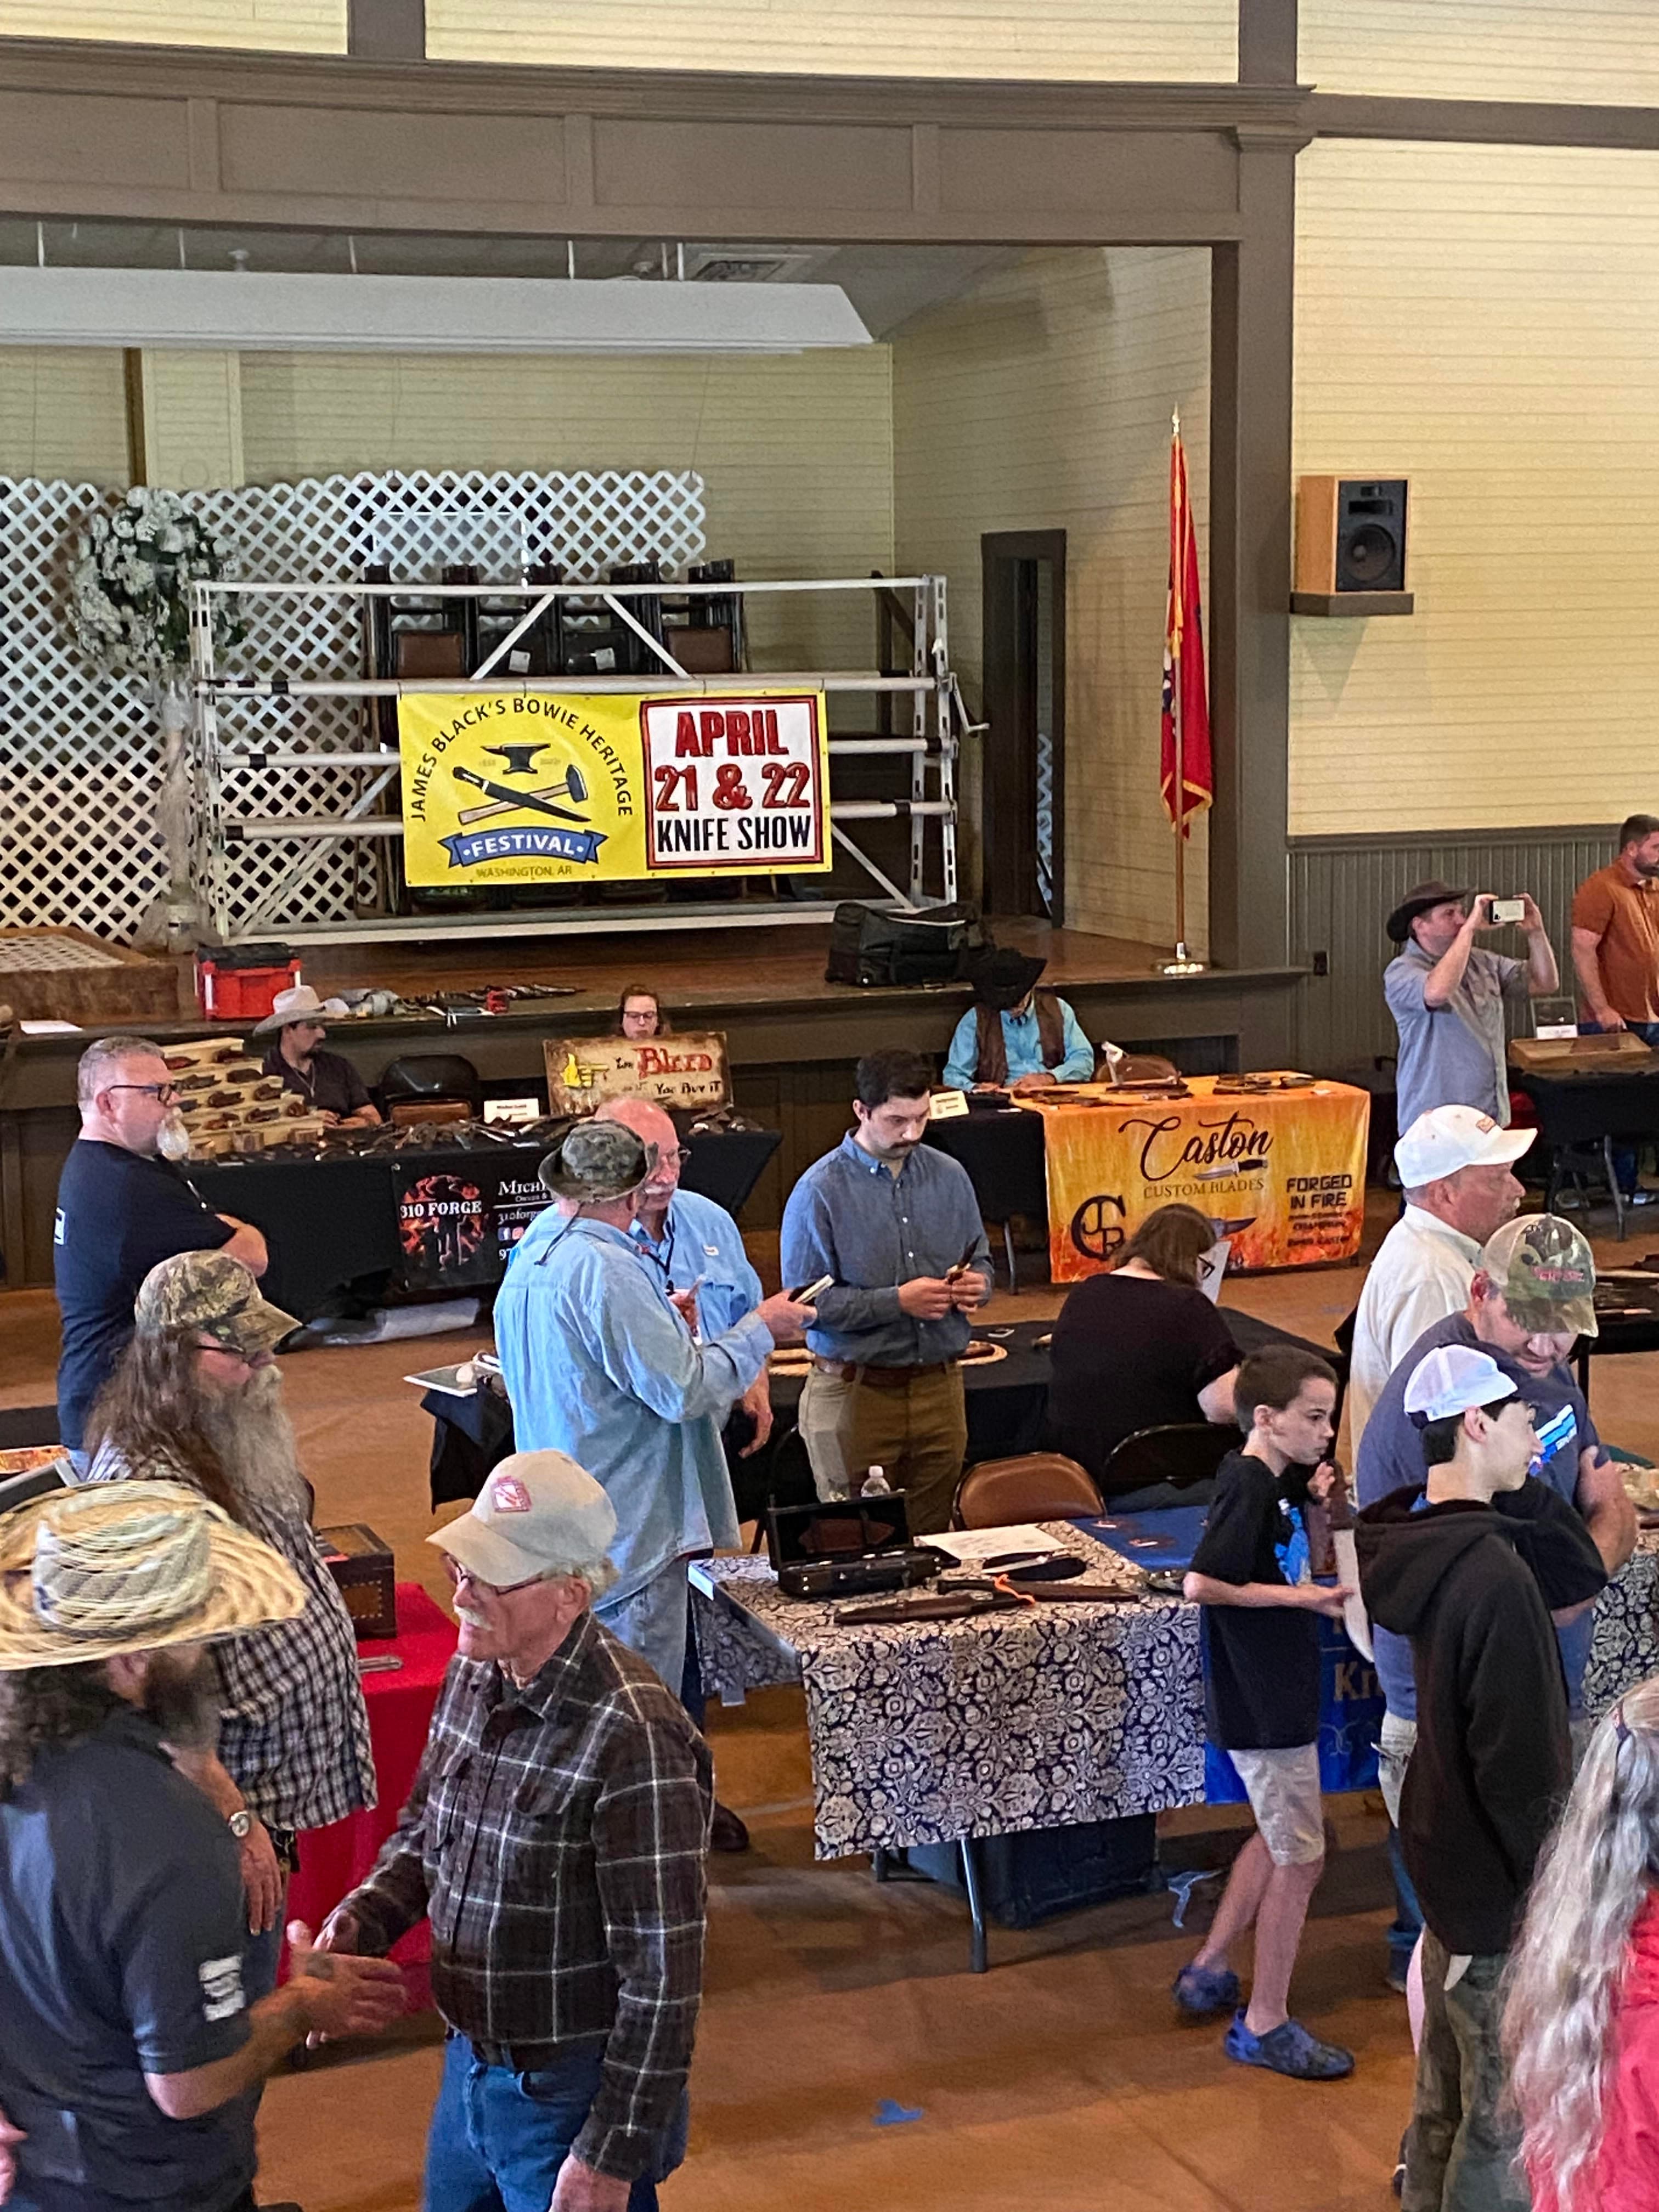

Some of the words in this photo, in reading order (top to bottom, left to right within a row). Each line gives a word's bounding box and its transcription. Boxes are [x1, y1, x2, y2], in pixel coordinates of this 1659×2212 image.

[675, 709, 789, 757] APRIL
[411, 753, 437, 822] JAMES
[432, 698, 506, 753] BLACK'S
[513, 697, 580, 730] BOWIE
[579, 724, 633, 816] HERITAGE
[654, 765, 698, 811] 21
[712, 763, 753, 810] &
[761, 762, 810, 809] 22
[657, 817, 729, 852] KNIFE
[737, 815, 811, 850] SHOW
[471, 833, 575, 857] FESTIVAL
[557, 865, 572, 875] AR
[1118, 1110, 1274, 1181] Caston
[1143, 1182, 1205, 1199] CUSTOM
[1210, 1178, 1264, 1193] BLADES
[1286, 1174, 1352, 1193] FORGED
[428, 1200, 482, 1216] FORGE
[1290, 1194, 1305, 1209] IN
[1311, 1192, 1347, 1208] FIRE
